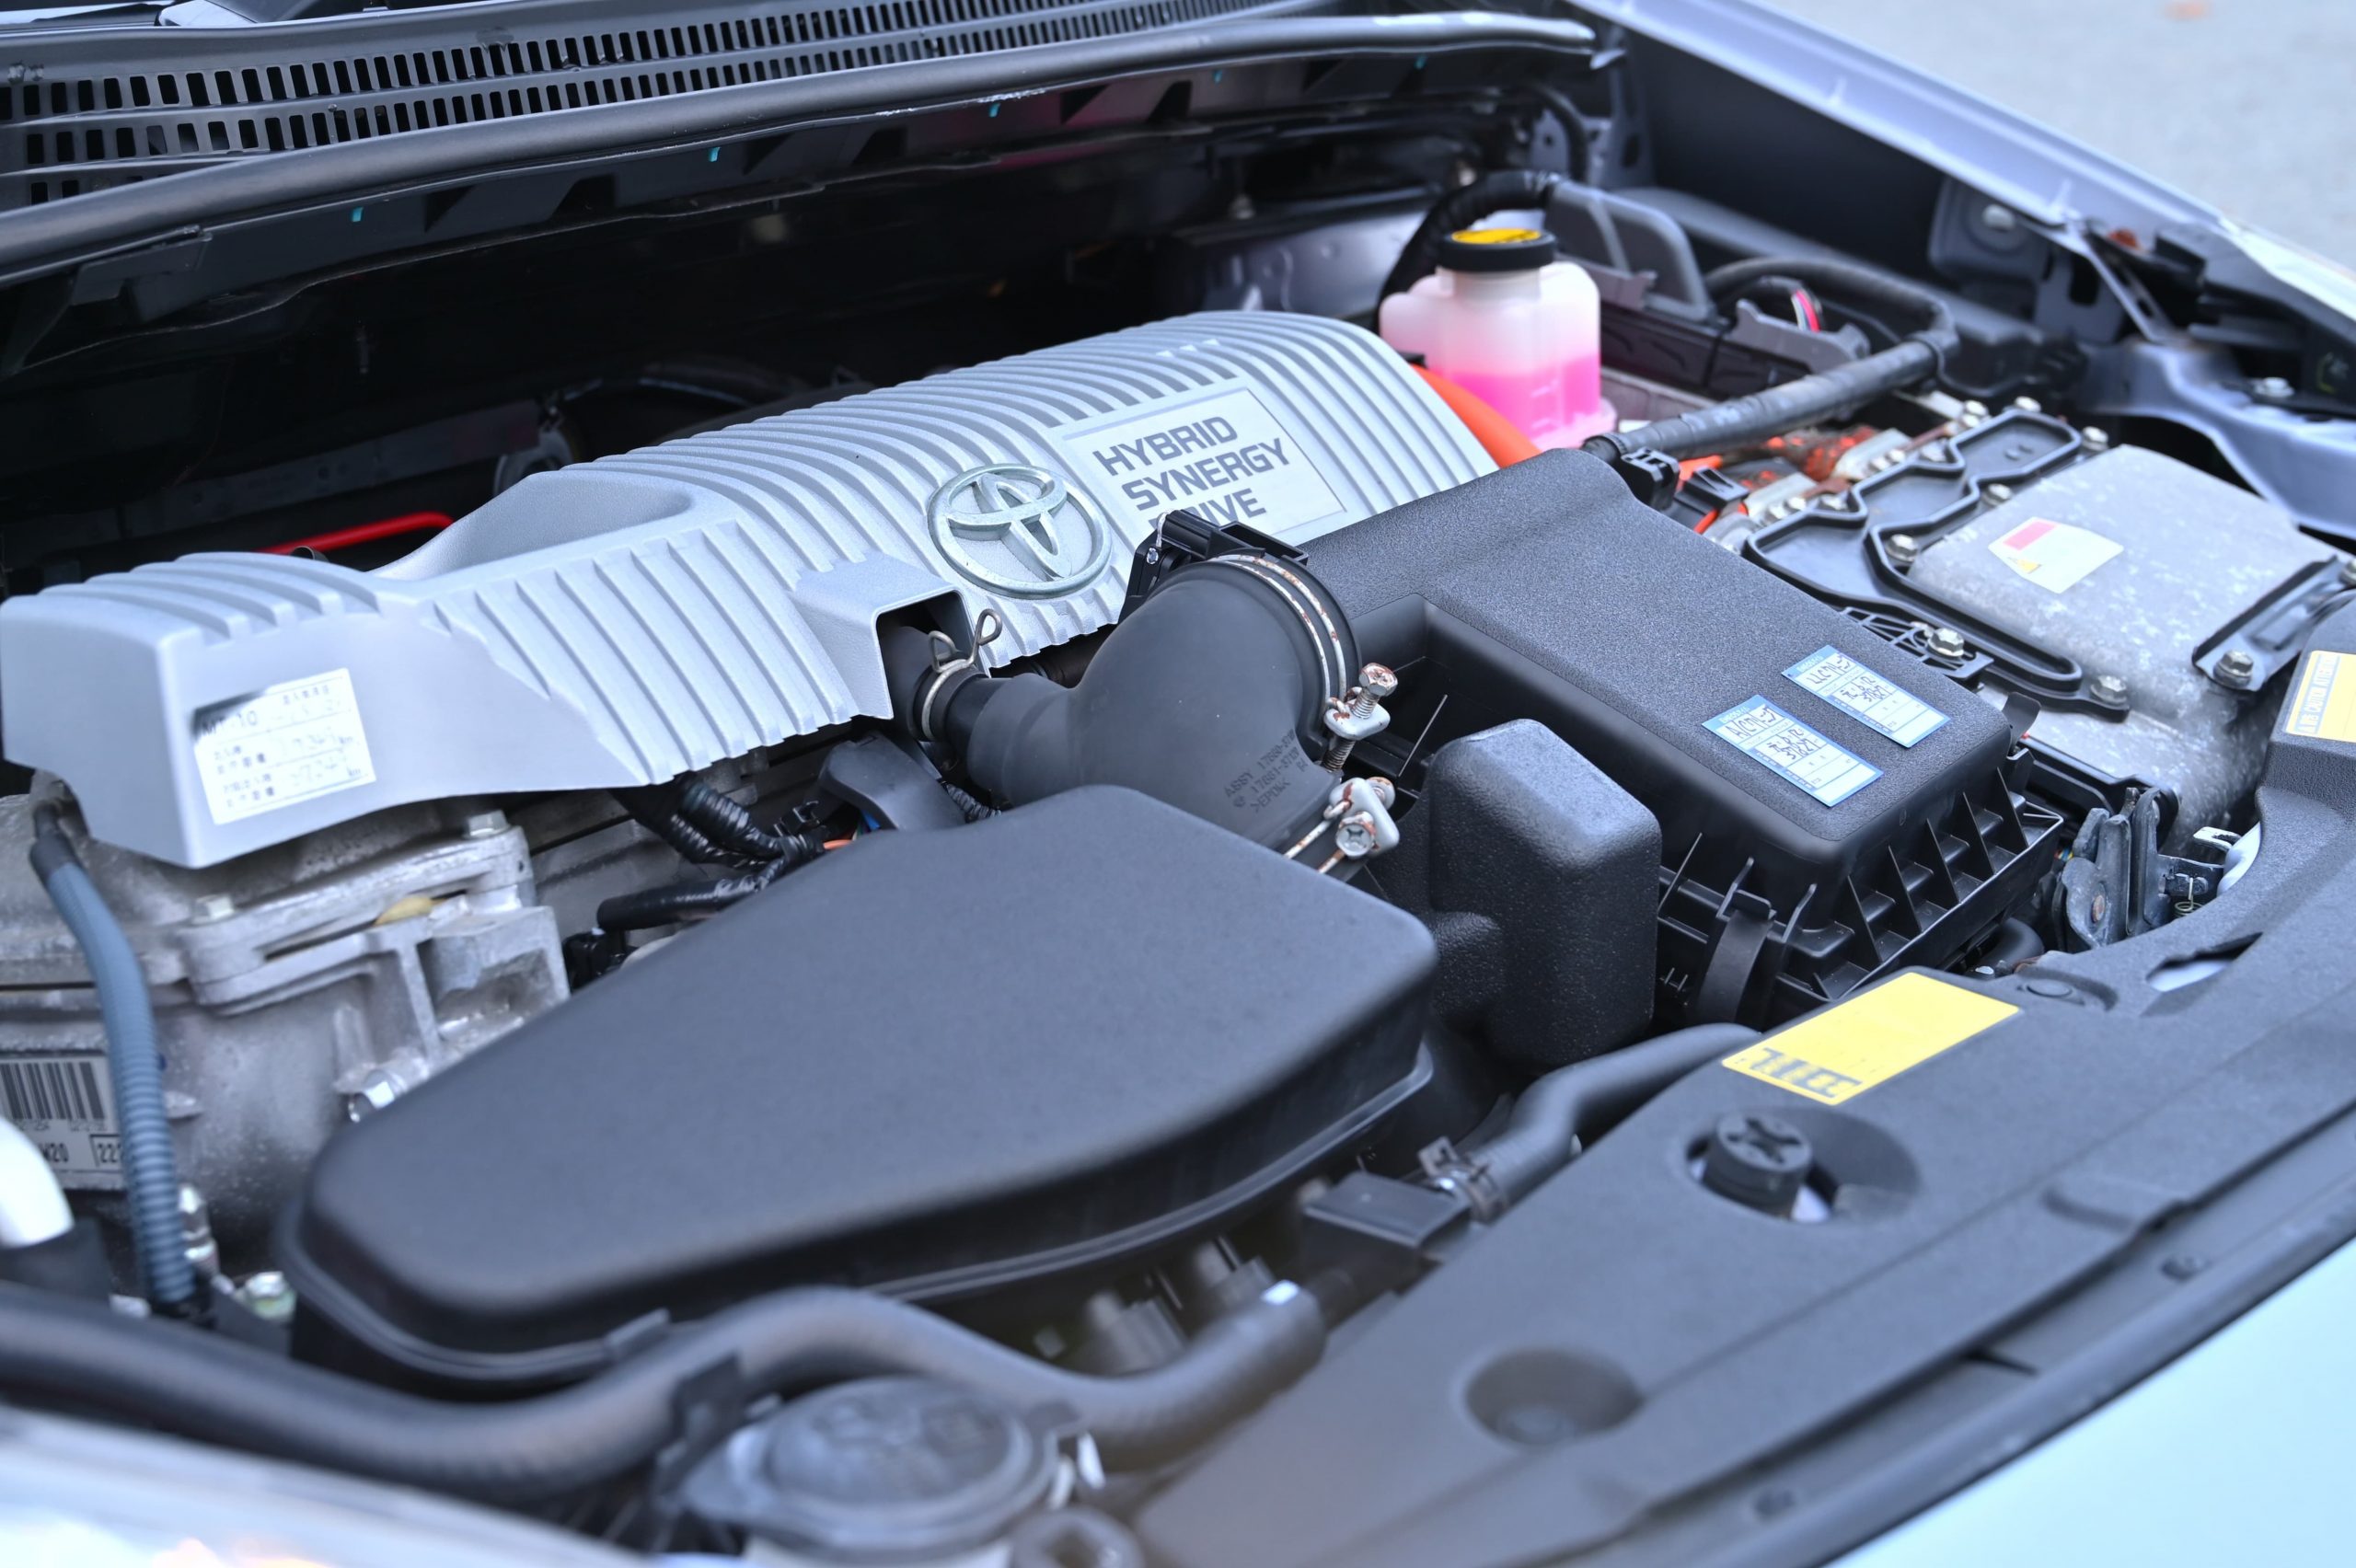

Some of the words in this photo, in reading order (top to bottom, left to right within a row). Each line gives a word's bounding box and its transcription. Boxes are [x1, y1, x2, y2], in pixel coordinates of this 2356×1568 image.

[1092, 416, 1237, 476] HYBRID
[1122, 437, 1289, 511] SYNERGY
[1149, 488, 1266, 533] IVE
